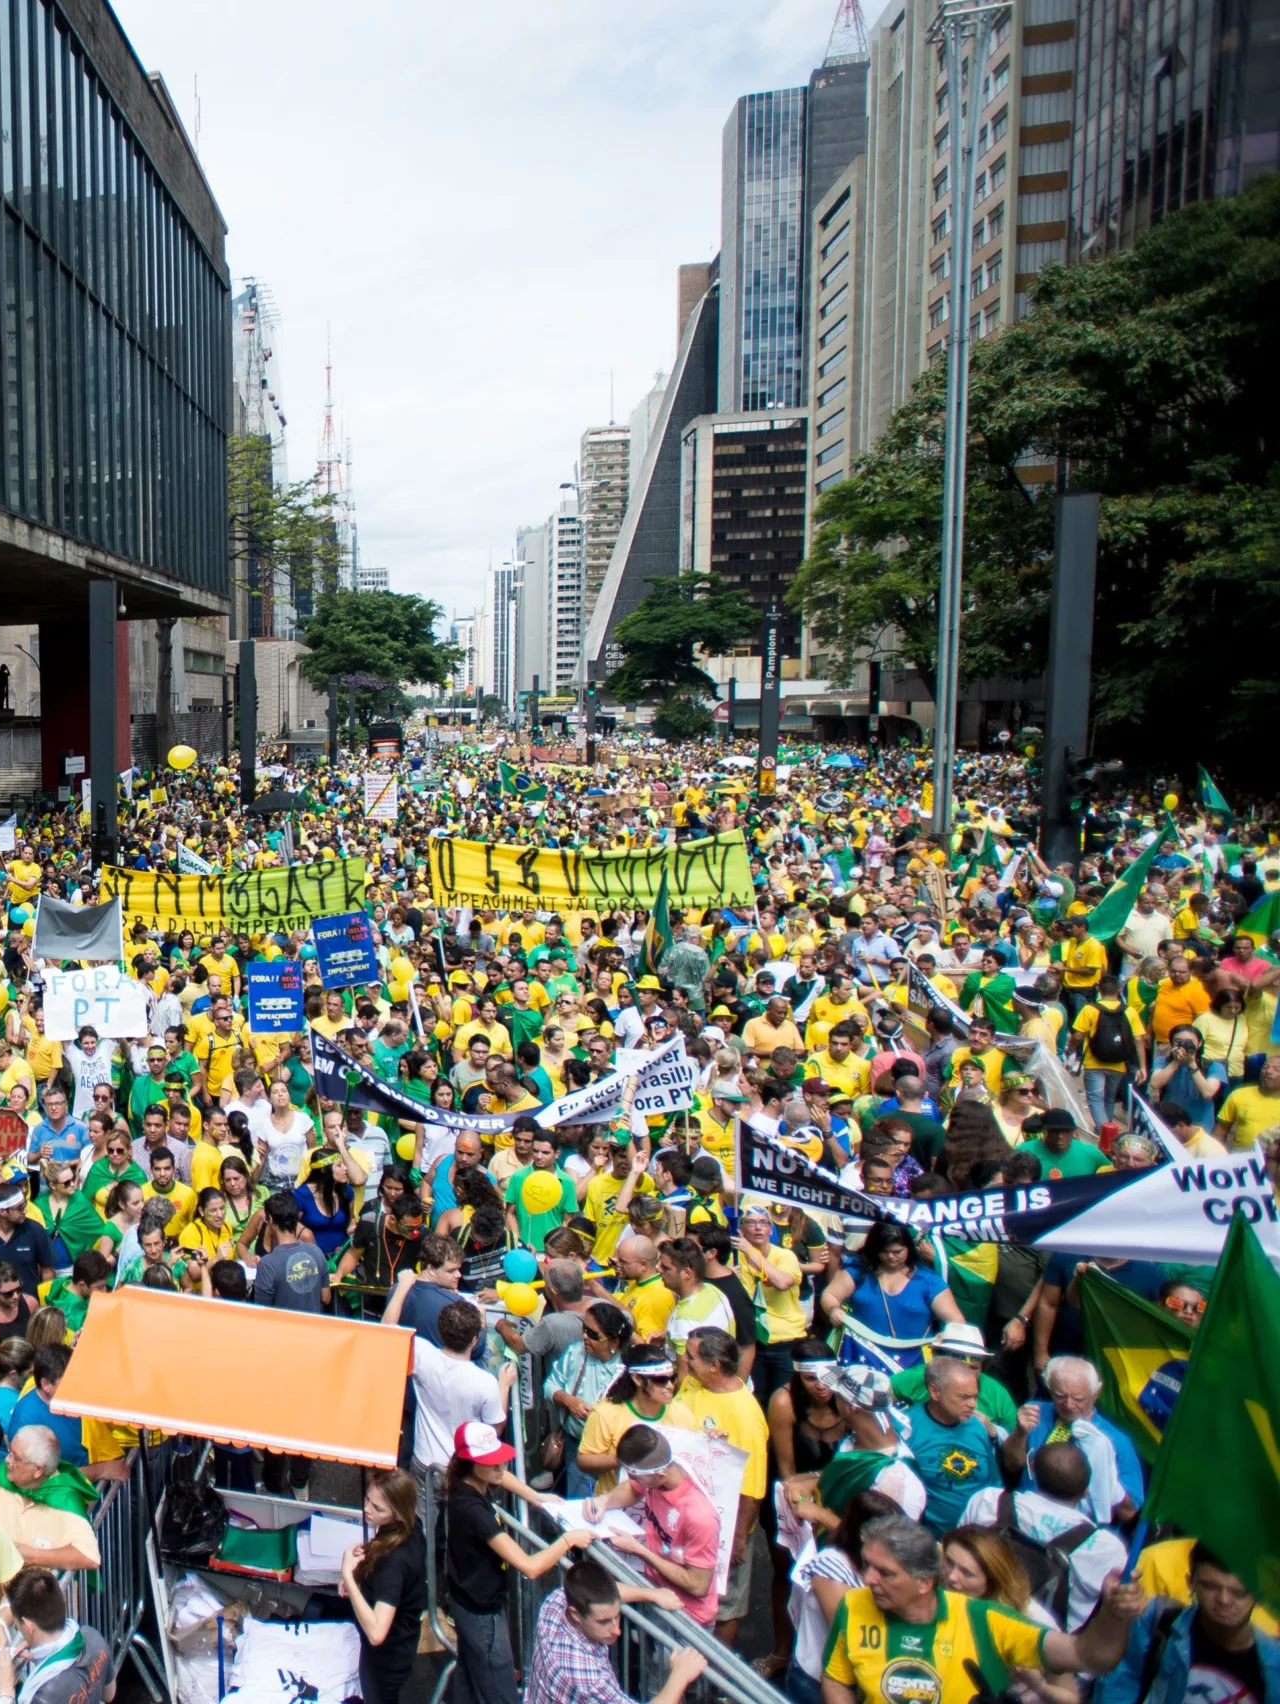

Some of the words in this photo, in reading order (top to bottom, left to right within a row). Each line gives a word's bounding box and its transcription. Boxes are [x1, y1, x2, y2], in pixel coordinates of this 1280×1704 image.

[765, 628, 777, 679] Pamplona
[765, 680, 774, 690] R.
[595, 897, 645, 912] FORA
[51, 971, 137, 995] FORA
[74, 997, 120, 1028] PT
[636, 1066, 689, 1091] rasil!
[634, 1095, 666, 1111] ora
[671, 1085, 694, 1105] PT
[442, 1113, 506, 1130] VIVER
[751, 1175, 778, 1195] WE
[782, 1179, 835, 1206] FIGHT
[839, 1194, 875, 1219] FOR
[1017, 1186, 1052, 1212] IS
[859, 1624, 882, 1650] 10
